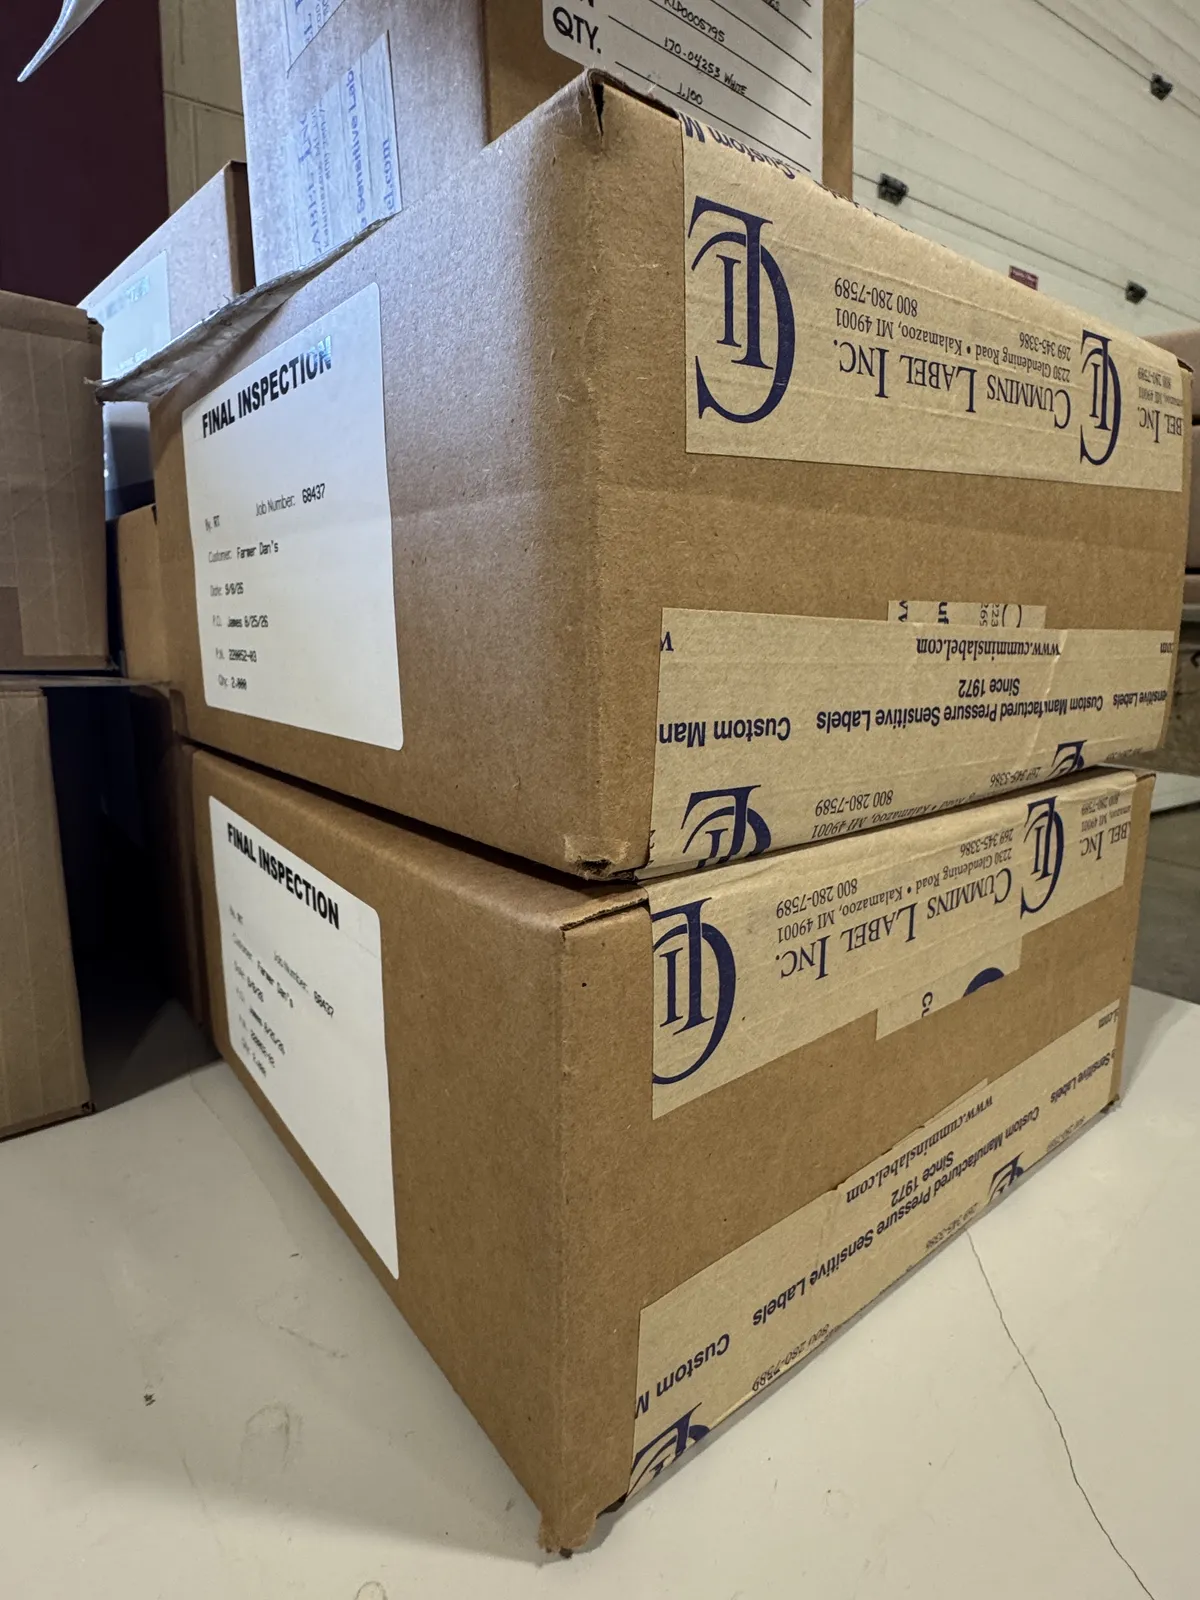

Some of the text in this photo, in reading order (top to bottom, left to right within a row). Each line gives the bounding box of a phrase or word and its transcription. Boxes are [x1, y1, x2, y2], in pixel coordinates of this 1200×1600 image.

[552, 6, 602, 54] QTY.
[834, 277, 920, 318] 800 280-7589
[835, 307, 1072, 384] 2230 Glendening Road Kalamazoo, MI 49001
[1019, 331, 1057, 360] 345-3386
[202, 335, 332, 439] FINAL INSPECTION
[833, 338, 1072, 430] CUMMINS LABEL INC.
[1136, 406, 1161, 444] INC.
[255, 501, 268, 517] Job
[301, 483, 326, 504] 68437
[236, 546, 257, 561] Farmer
[259, 540, 279, 556] Dan's
[916, 637, 1062, 662] www.cumminslabel.com
[958, 677, 1021, 699] Since 1972
[1070, 694, 1104, 712] Custom
[1112, 692, 1138, 708] Labels
[816, 709, 872, 734] Labels
[874, 706, 941, 731] Sensitive
[944, 703, 998, 722] Pressure
[658, 716, 791, 748] Custom Man
[815, 789, 894, 818] 800 280-7589
[1078, 829, 1104, 862] INC.
[227, 821, 340, 931] FINAL INSPECTION
[776, 878, 859, 919] 800 280-7589
[777, 847, 1013, 944] 2230 Glendening Road Kalamazoo, MI 49001
[775, 866, 1013, 981] CUMMINS LABEL INC.
[1049, 1080, 1077, 1104] Labels
[1004, 1105, 1041, 1140] Custom
[846, 1095, 993, 1204] www.cumminslabel.com
[922, 1150, 955, 1183] Since
[932, 1131, 1004, 1197] Manufactured
[890, 1175, 919, 1208] 1972
[876, 1188, 932, 1235] Pressure
[809, 1228, 874, 1286] Sensitive
[752, 1276, 807, 1327] Labels
[656, 1332, 731, 1398] Custom
